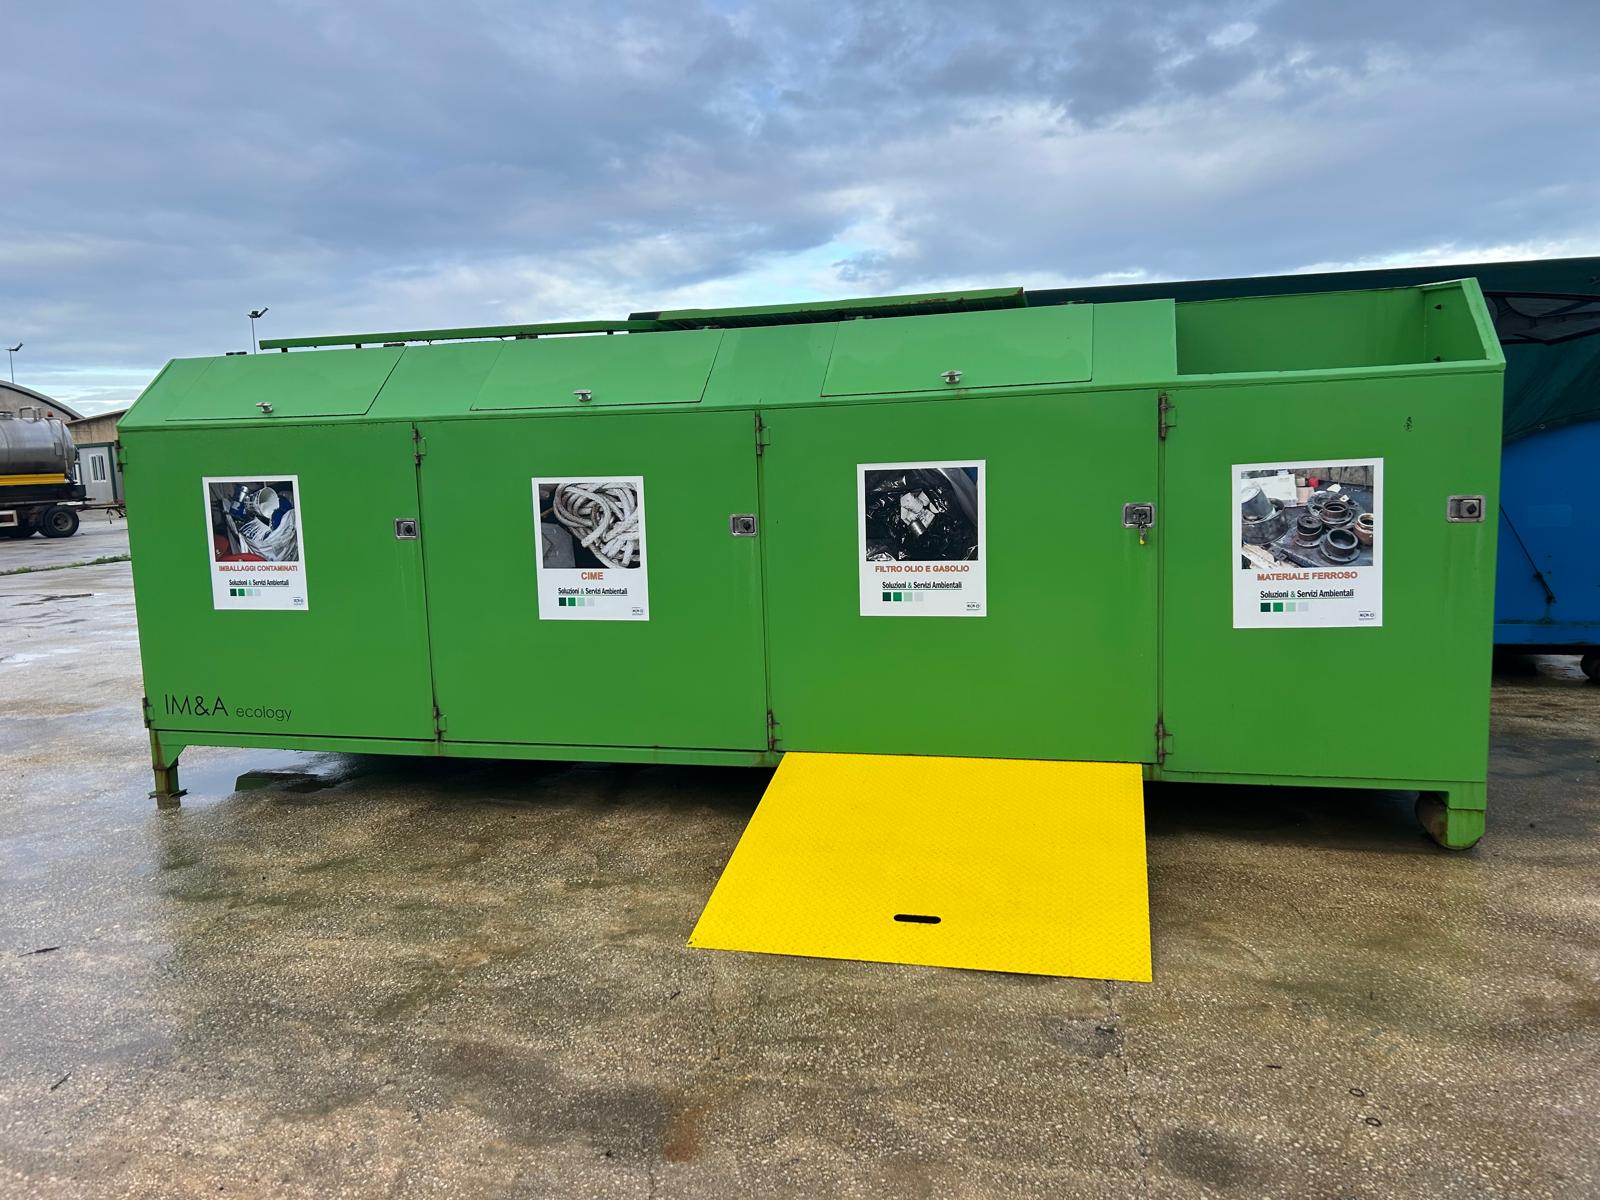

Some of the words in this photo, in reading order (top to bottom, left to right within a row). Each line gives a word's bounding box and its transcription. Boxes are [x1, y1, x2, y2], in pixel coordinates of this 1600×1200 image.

[581, 572, 604, 580] CIME
[1257, 573, 1309, 581] MATERIALE
[1312, 571, 1358, 579] FERROSO
[1260, 590, 1288, 598] Soluzioni
[1319, 589, 1354, 597] Ambientali
[165, 694, 228, 716] IM&A
[236, 706, 292, 721] ecology
